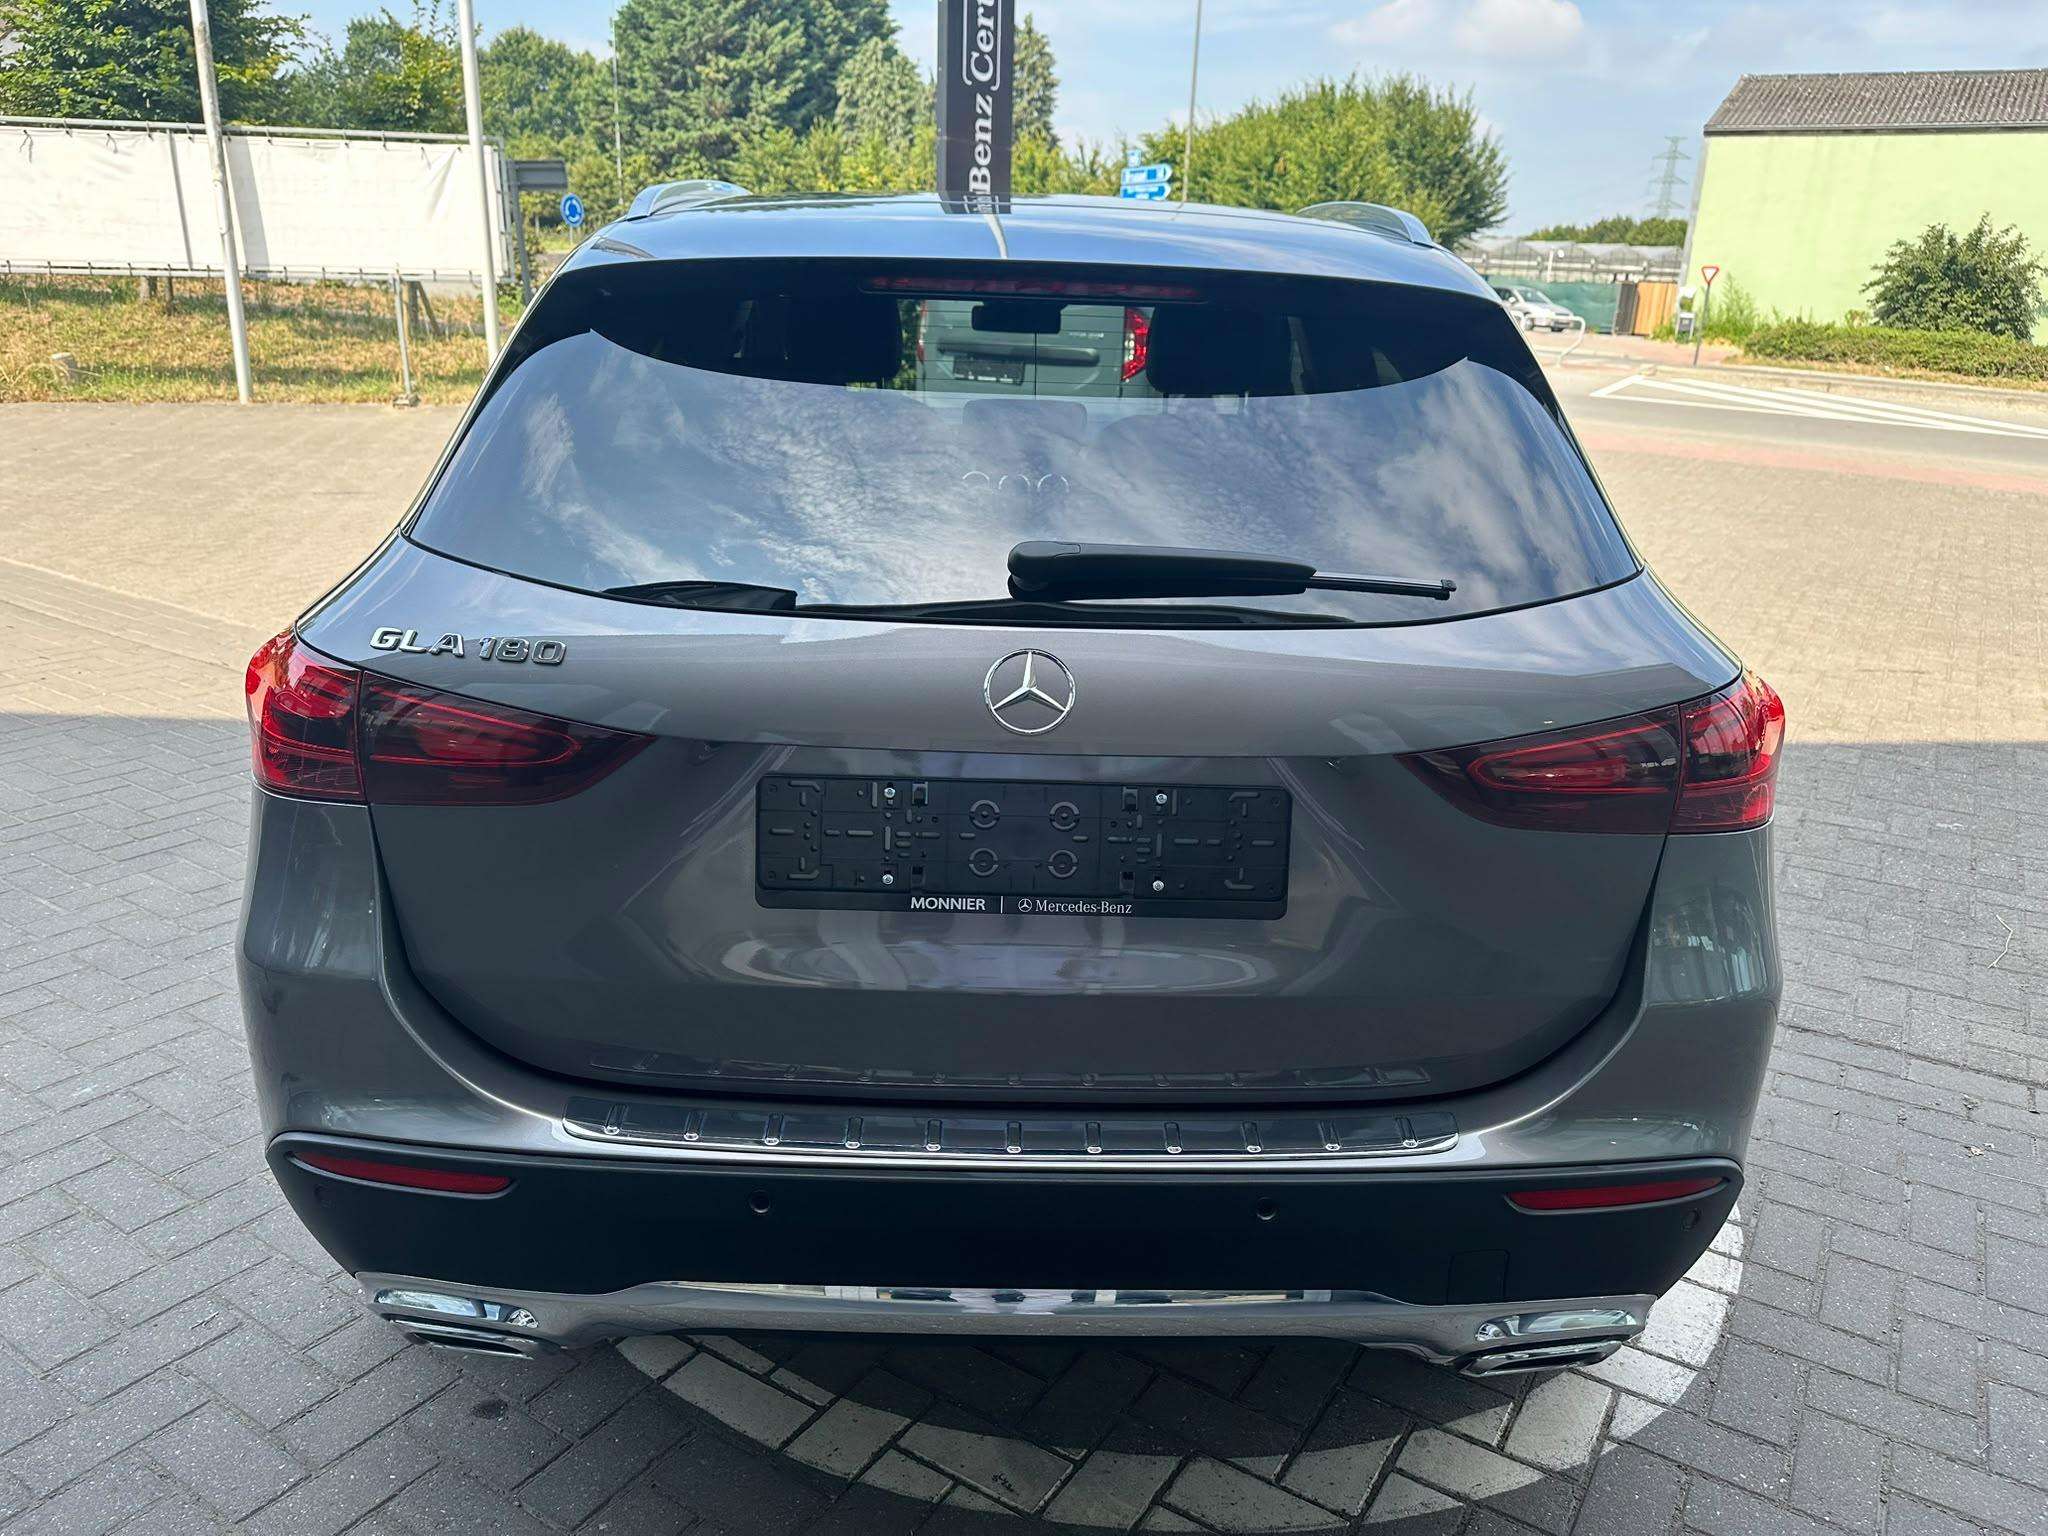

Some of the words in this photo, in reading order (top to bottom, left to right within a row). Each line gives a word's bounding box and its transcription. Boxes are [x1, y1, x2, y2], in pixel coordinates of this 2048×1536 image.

[370, 626, 464, 658] GLA
[478, 636, 567, 665] 180
[910, 897, 986, 911] MONNIER
[1036, 899, 1132, 914] Mercedes-Benz
